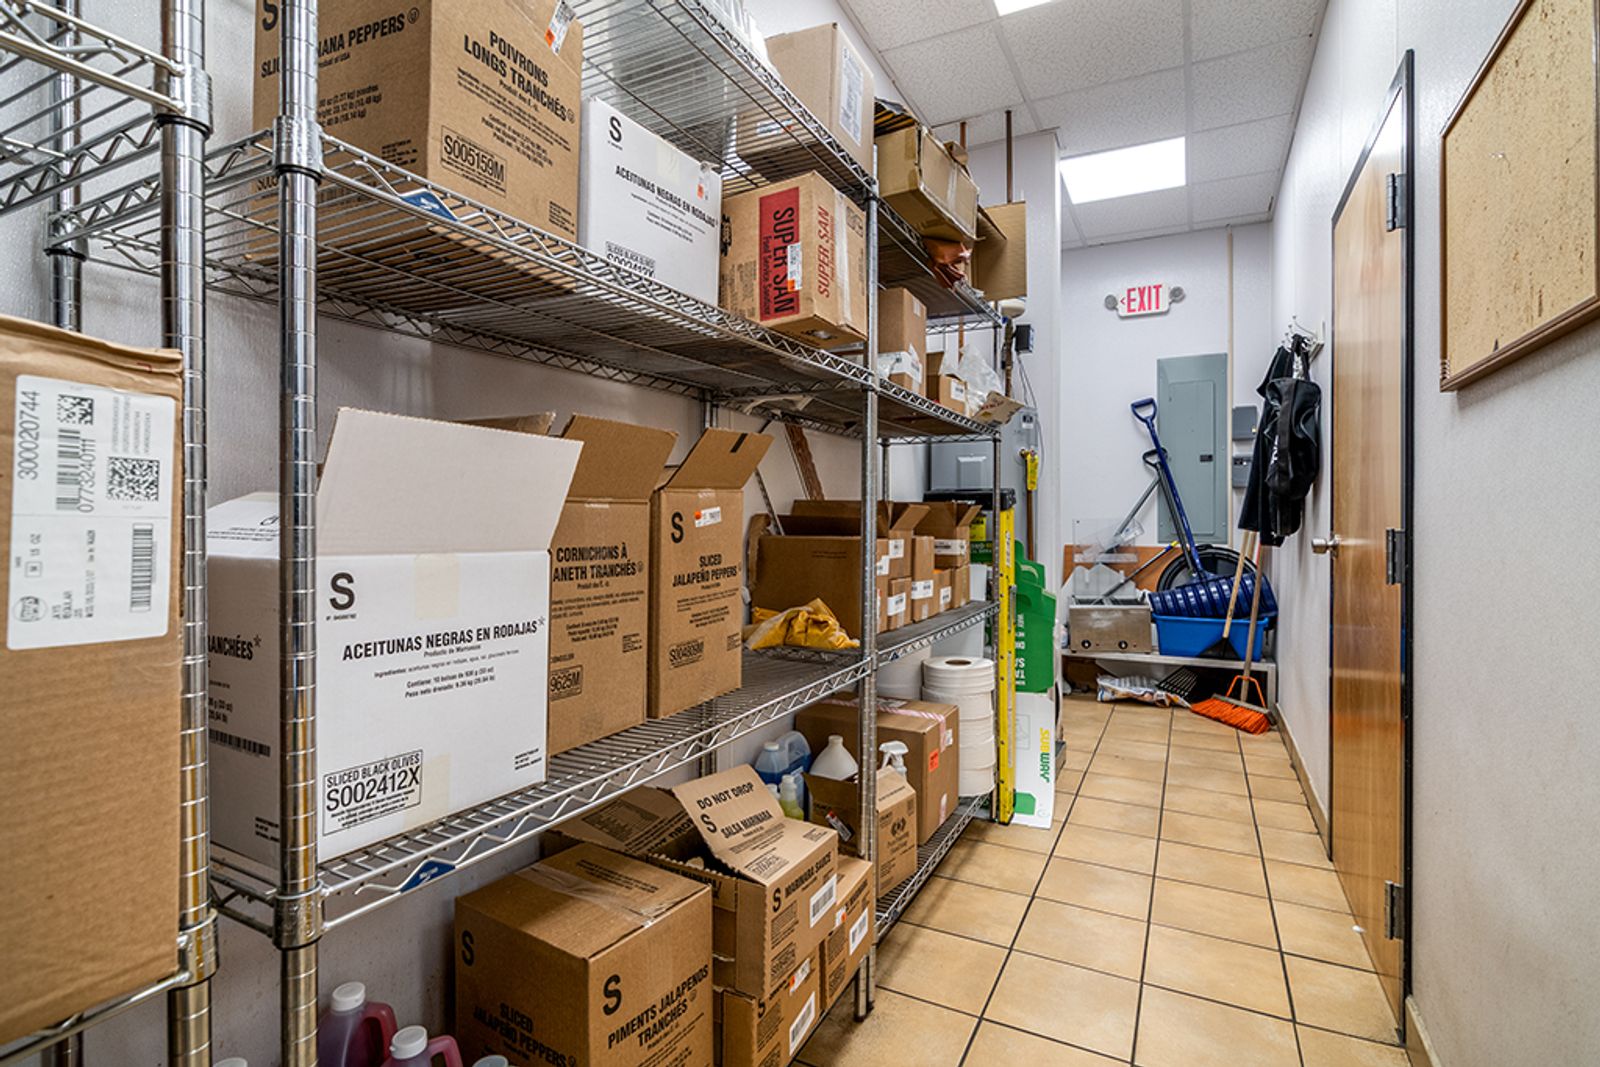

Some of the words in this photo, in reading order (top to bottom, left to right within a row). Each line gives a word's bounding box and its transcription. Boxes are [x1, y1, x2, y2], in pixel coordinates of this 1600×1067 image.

[261, 57, 280, 78] SLI
[348, 13, 405, 47] PEPPERS
[490, 30, 548, 87] POIVRONS
[464, 34, 507, 78] LONGS
[510, 67, 567, 121] TRANCHÉS
[609, 116, 623, 143] S
[444, 134, 504, 182] S005159M
[615, 165, 656, 195] ACEITUNAS
[773, 207, 795, 269] SUPER
[817, 205, 830, 243] SAN
[818, 244, 830, 299] SUPER
[773, 275, 795, 314] SAN
[1127, 284, 1163, 313] EXIT
[17, 390, 40, 481] 300020744
[671, 511, 684, 543] S
[556, 546, 620, 563] CORNICHONS
[590, 560, 637, 580] TRANCHÉS
[699, 554, 722, 568] SLICED
[711, 565, 737, 581] PEPPERS
[329, 572, 356, 611] S
[342, 635, 423, 661] ACEITUNAS
[426, 629, 474, 649] NEGRAS
[476, 626, 491, 642] EN
[326, 770, 360, 788] SLICED
[361, 760, 390, 779] BLACK
[391, 753, 420, 770] OLIVES
[1039, 728, 1051, 783] SUBWAY
[326, 765, 420, 811] S002412X
[696, 798, 713, 810] DO
[714, 790, 733, 805] NOT
[731, 781, 755, 797] DROP
[700, 813, 718, 834] S
[773, 887, 781, 913] S
[462, 930, 474, 966] S
[603, 974, 621, 1016] S
[500, 1002, 533, 1034] SLICED
[608, 1004, 657, 1049] PIMENTS
